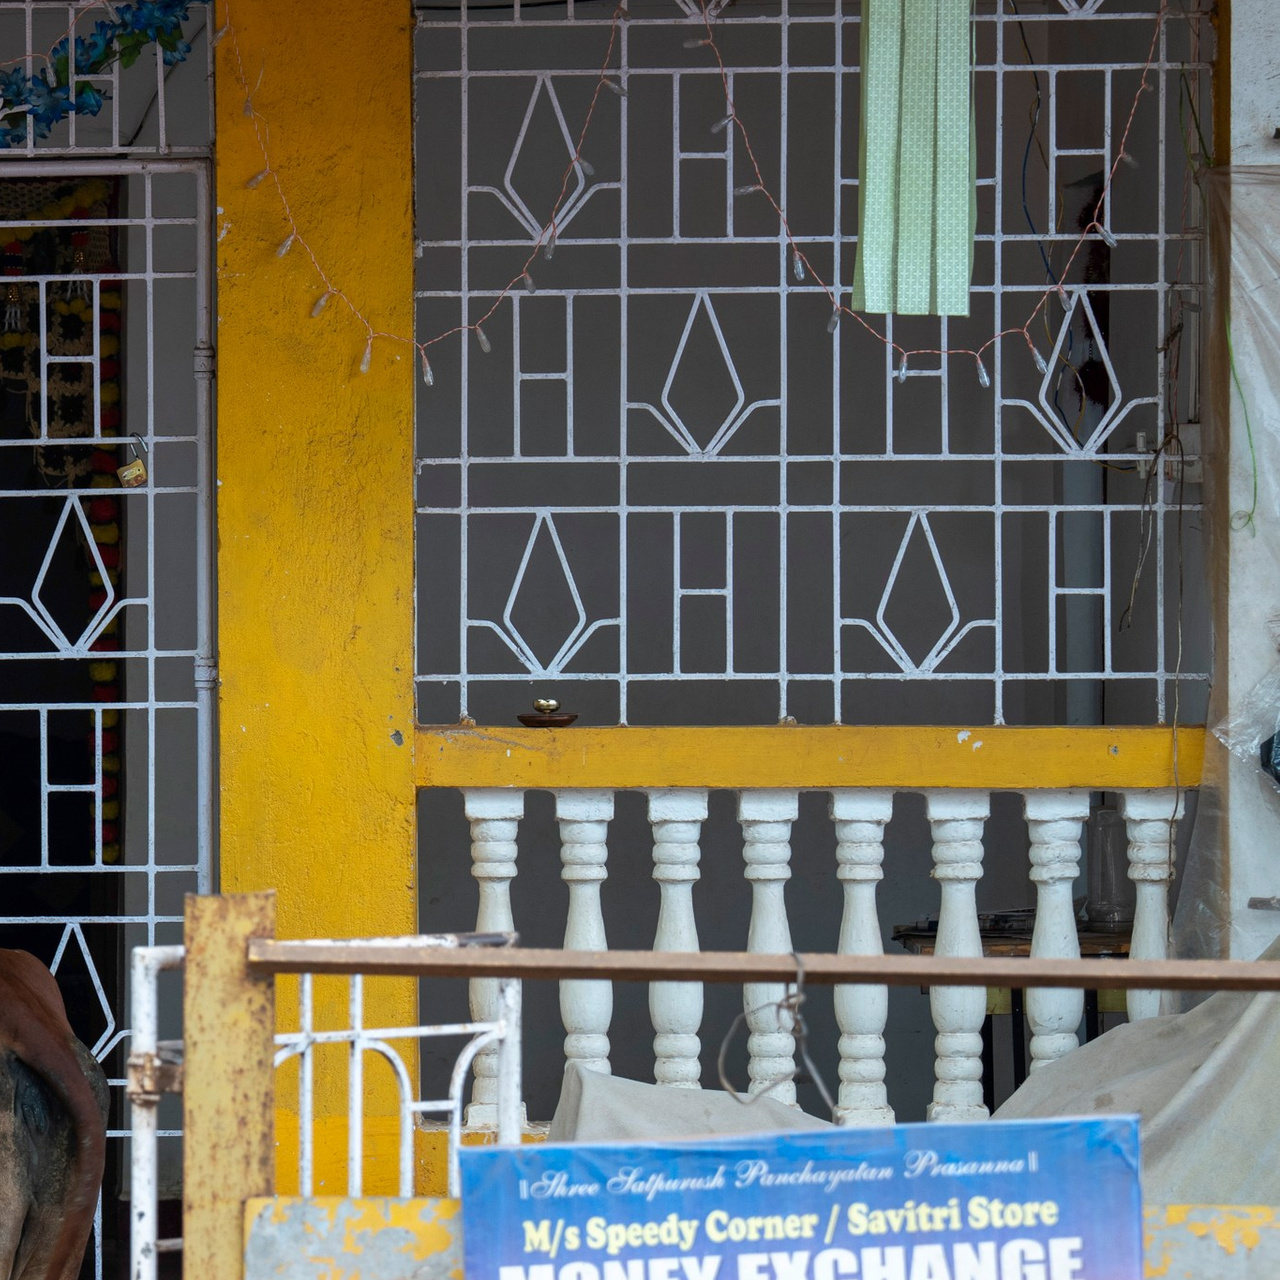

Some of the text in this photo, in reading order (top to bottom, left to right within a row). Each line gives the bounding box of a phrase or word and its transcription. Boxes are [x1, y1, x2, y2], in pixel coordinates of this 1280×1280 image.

[734, 1158, 893, 1193] Panchayatan
[523, 1219, 582, 1258] M/s
[585, 1214, 698, 1254] Speedy
[705, 1209, 818, 1243] Corner
[847, 1197, 962, 1236] Savitri
[967, 1195, 1058, 1228] Store
